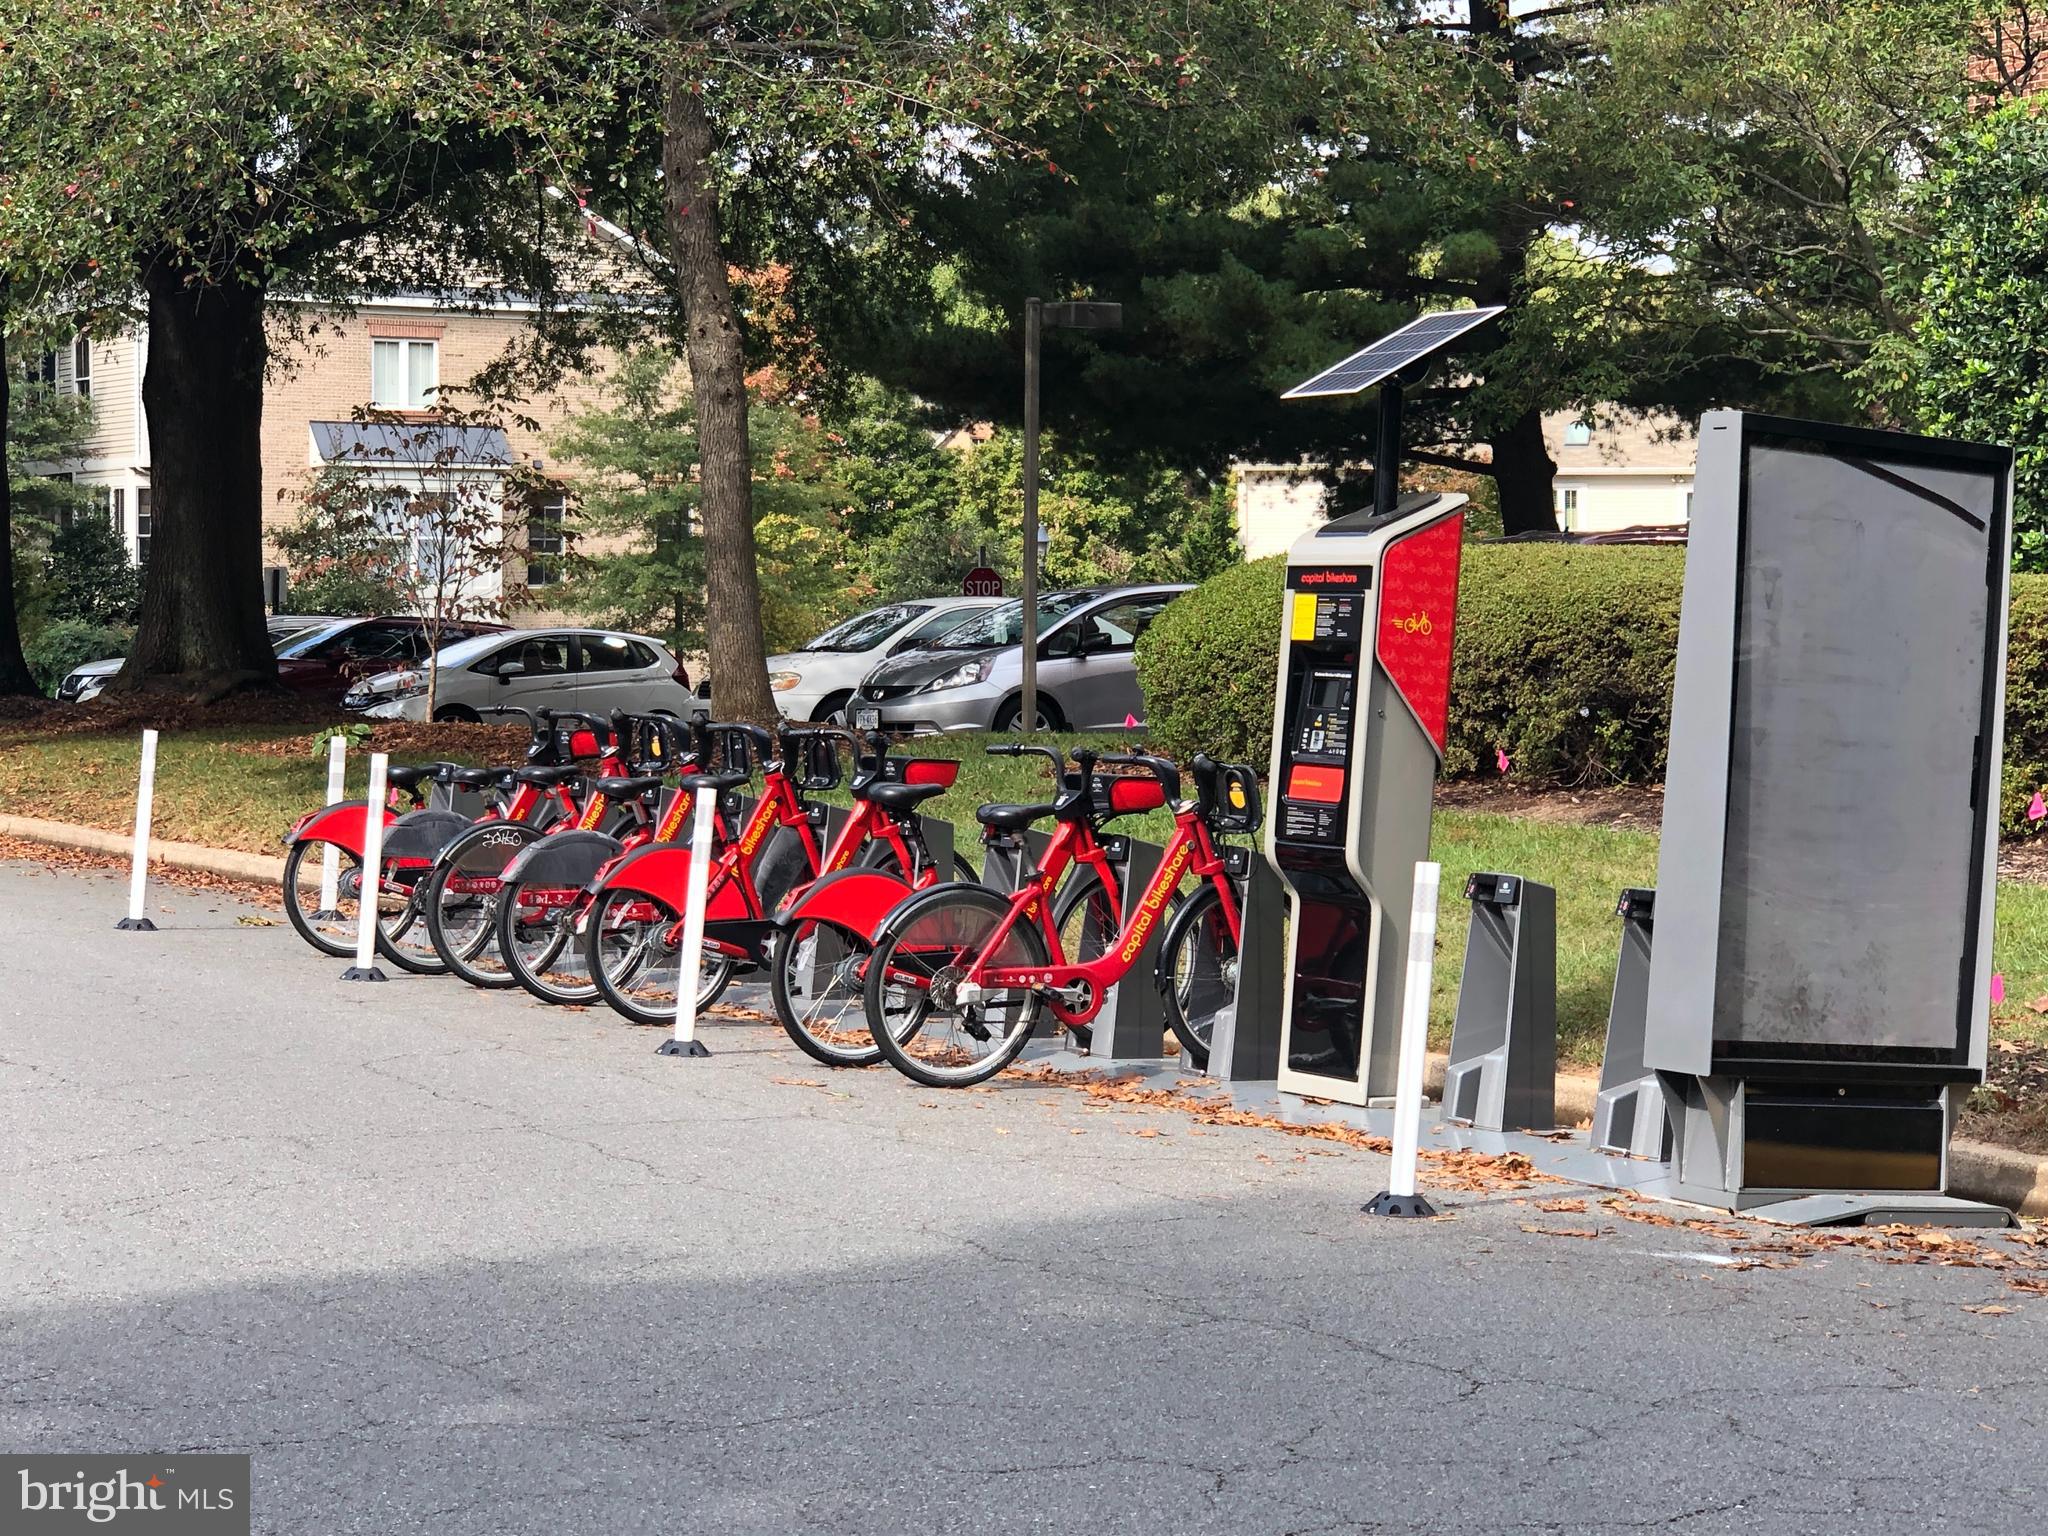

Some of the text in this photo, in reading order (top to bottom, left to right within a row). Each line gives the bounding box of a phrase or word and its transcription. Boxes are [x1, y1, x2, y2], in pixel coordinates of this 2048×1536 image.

[966, 580, 1001, 596] STOP
[1300, 571, 1358, 585] capital bikeshare
[740, 800, 778, 855] bikeshare
[1121, 844, 1189, 963] capital bikeshare
